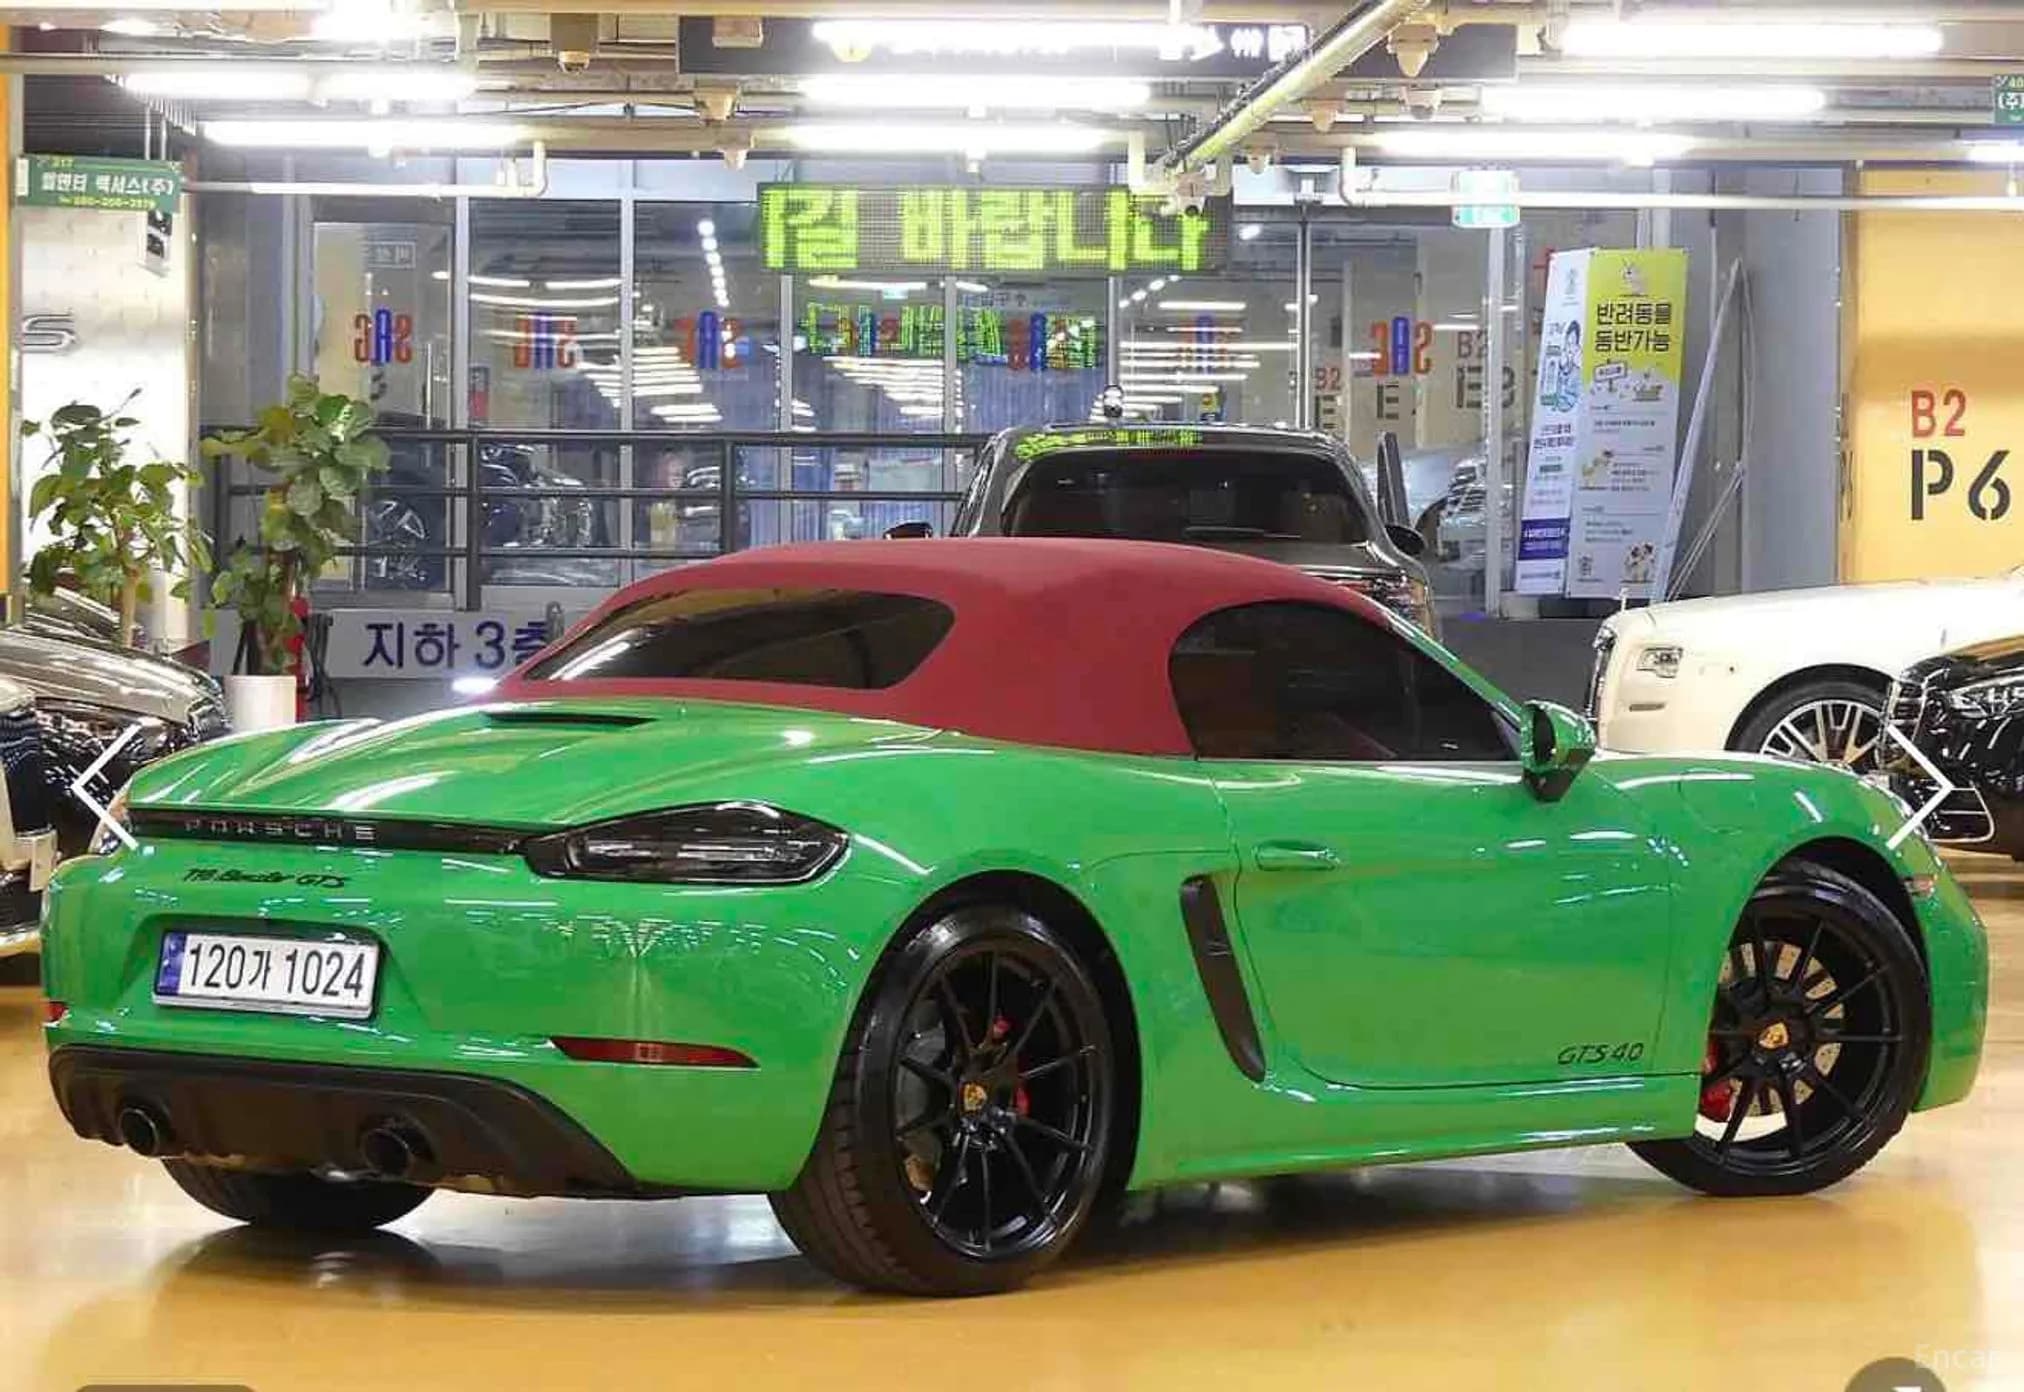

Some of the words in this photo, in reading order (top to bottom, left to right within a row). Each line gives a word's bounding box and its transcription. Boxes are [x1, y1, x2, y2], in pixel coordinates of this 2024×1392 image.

[900, 189, 1208, 271] 바랍니다
[1597, 302, 1672, 326] 반려동물
[1594, 330, 1671, 353] 동반가능
[1911, 389, 1967, 438] B2
[363, 622, 461, 669] 지하
[184, 818, 375, 841] PORSCHE
[189, 943, 271, 991] 120가
[285, 948, 366, 998] 1024
